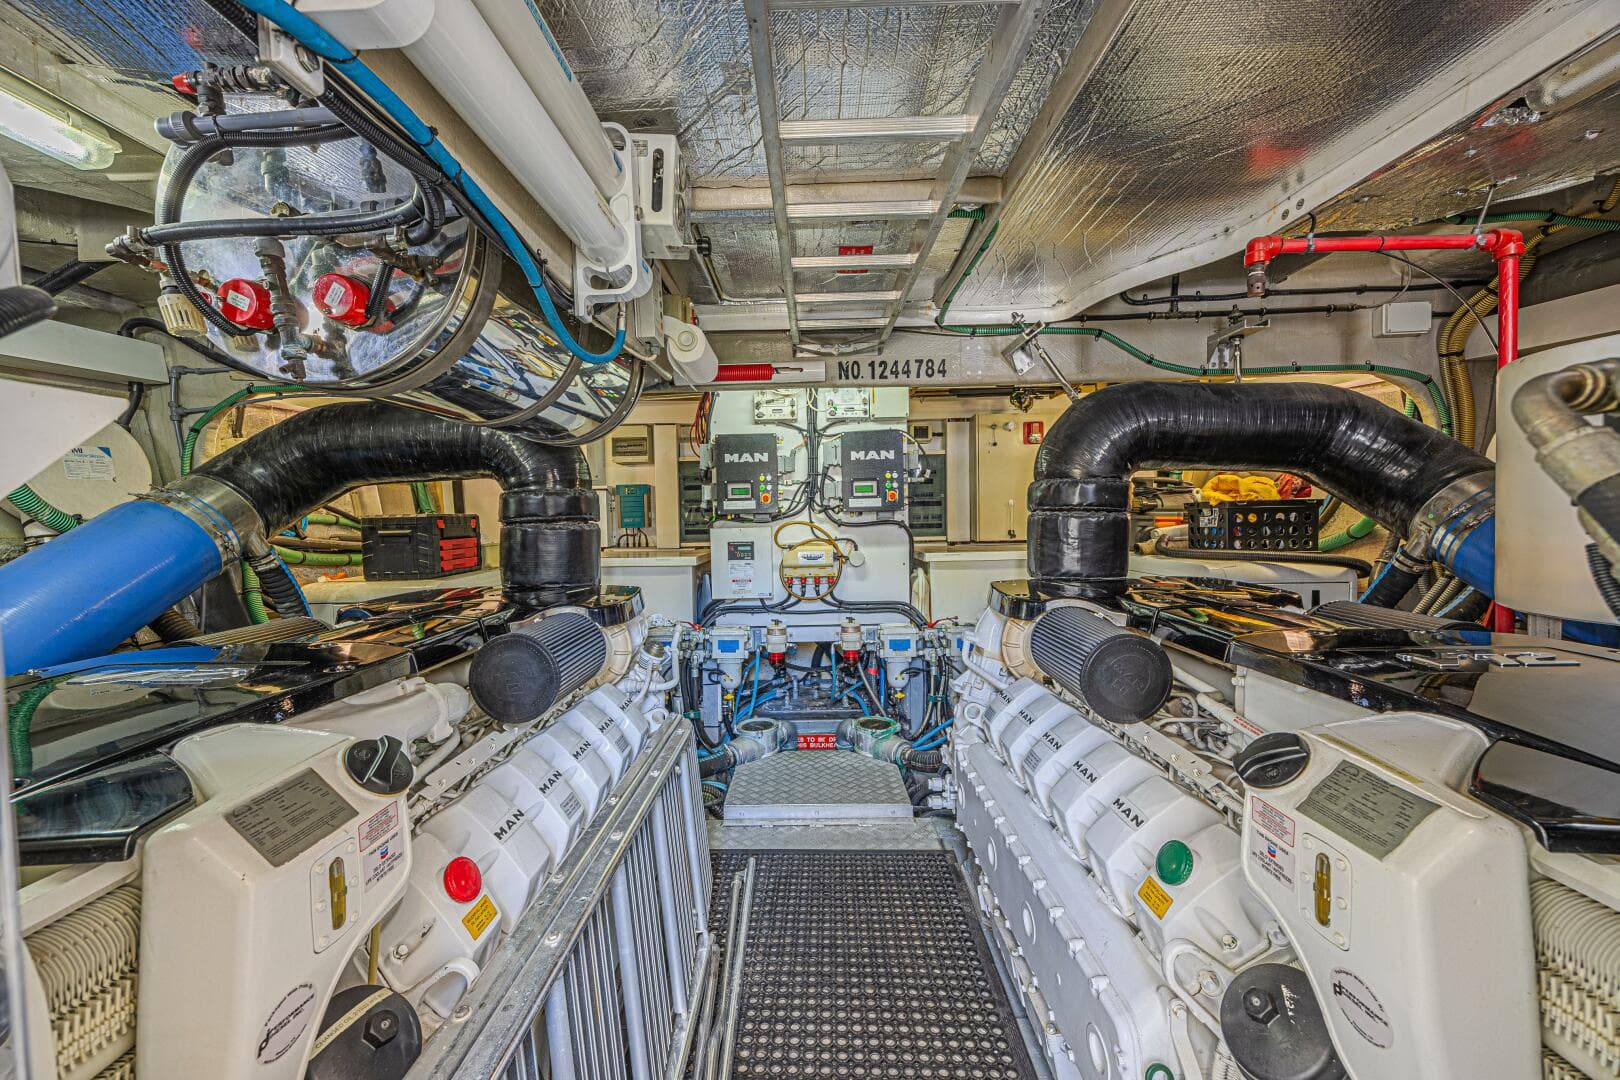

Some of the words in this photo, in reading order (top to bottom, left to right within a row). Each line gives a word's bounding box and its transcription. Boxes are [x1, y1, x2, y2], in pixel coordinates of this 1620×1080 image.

[724, 452, 769, 463] MAN
[850, 449, 895, 461] MAN
[620, 698, 634, 711] MAN
[998, 690, 1012, 704] MAN
[598, 717, 616, 734] MAN
[1018, 709, 1036, 725] MAN
[572, 740, 593, 760] MAN
[1042, 731, 1064, 751] MAN
[1072, 760, 1098, 784] MAN
[538, 770, 563, 795] MAN
[1113, 797, 1145, 827] MAN
[494, 809, 525, 841] MAN
